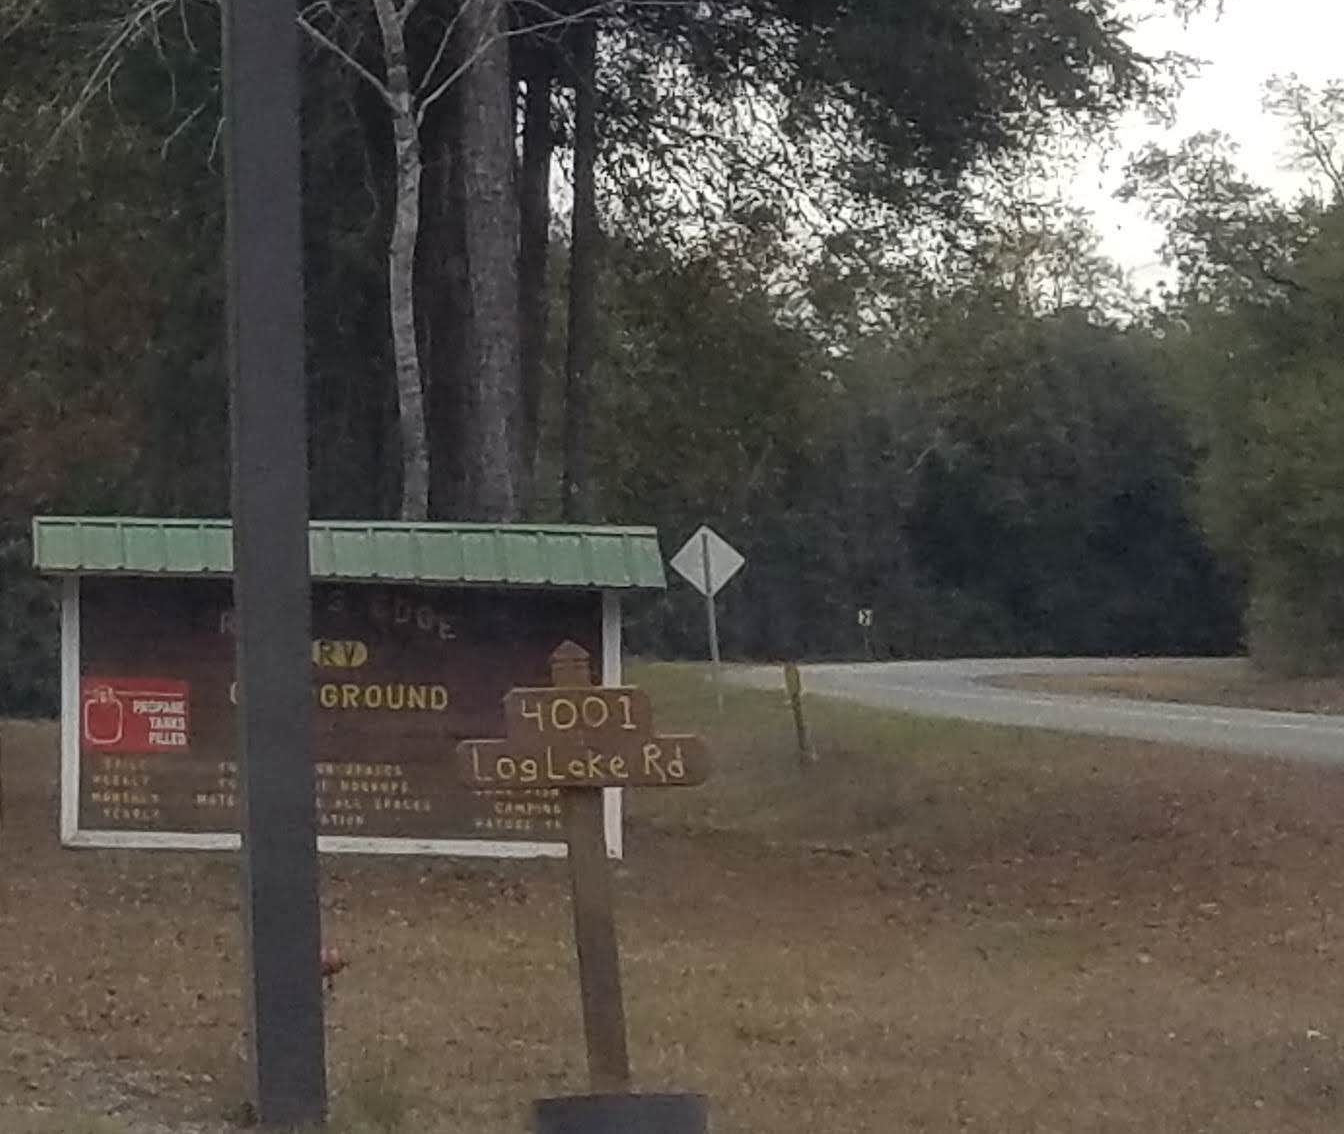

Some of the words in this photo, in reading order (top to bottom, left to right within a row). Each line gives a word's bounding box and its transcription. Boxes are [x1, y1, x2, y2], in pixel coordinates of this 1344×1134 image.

[521, 695, 637, 731] 4001
[149, 732, 186, 745] FILLED
[642, 744, 684, 782] Rd
